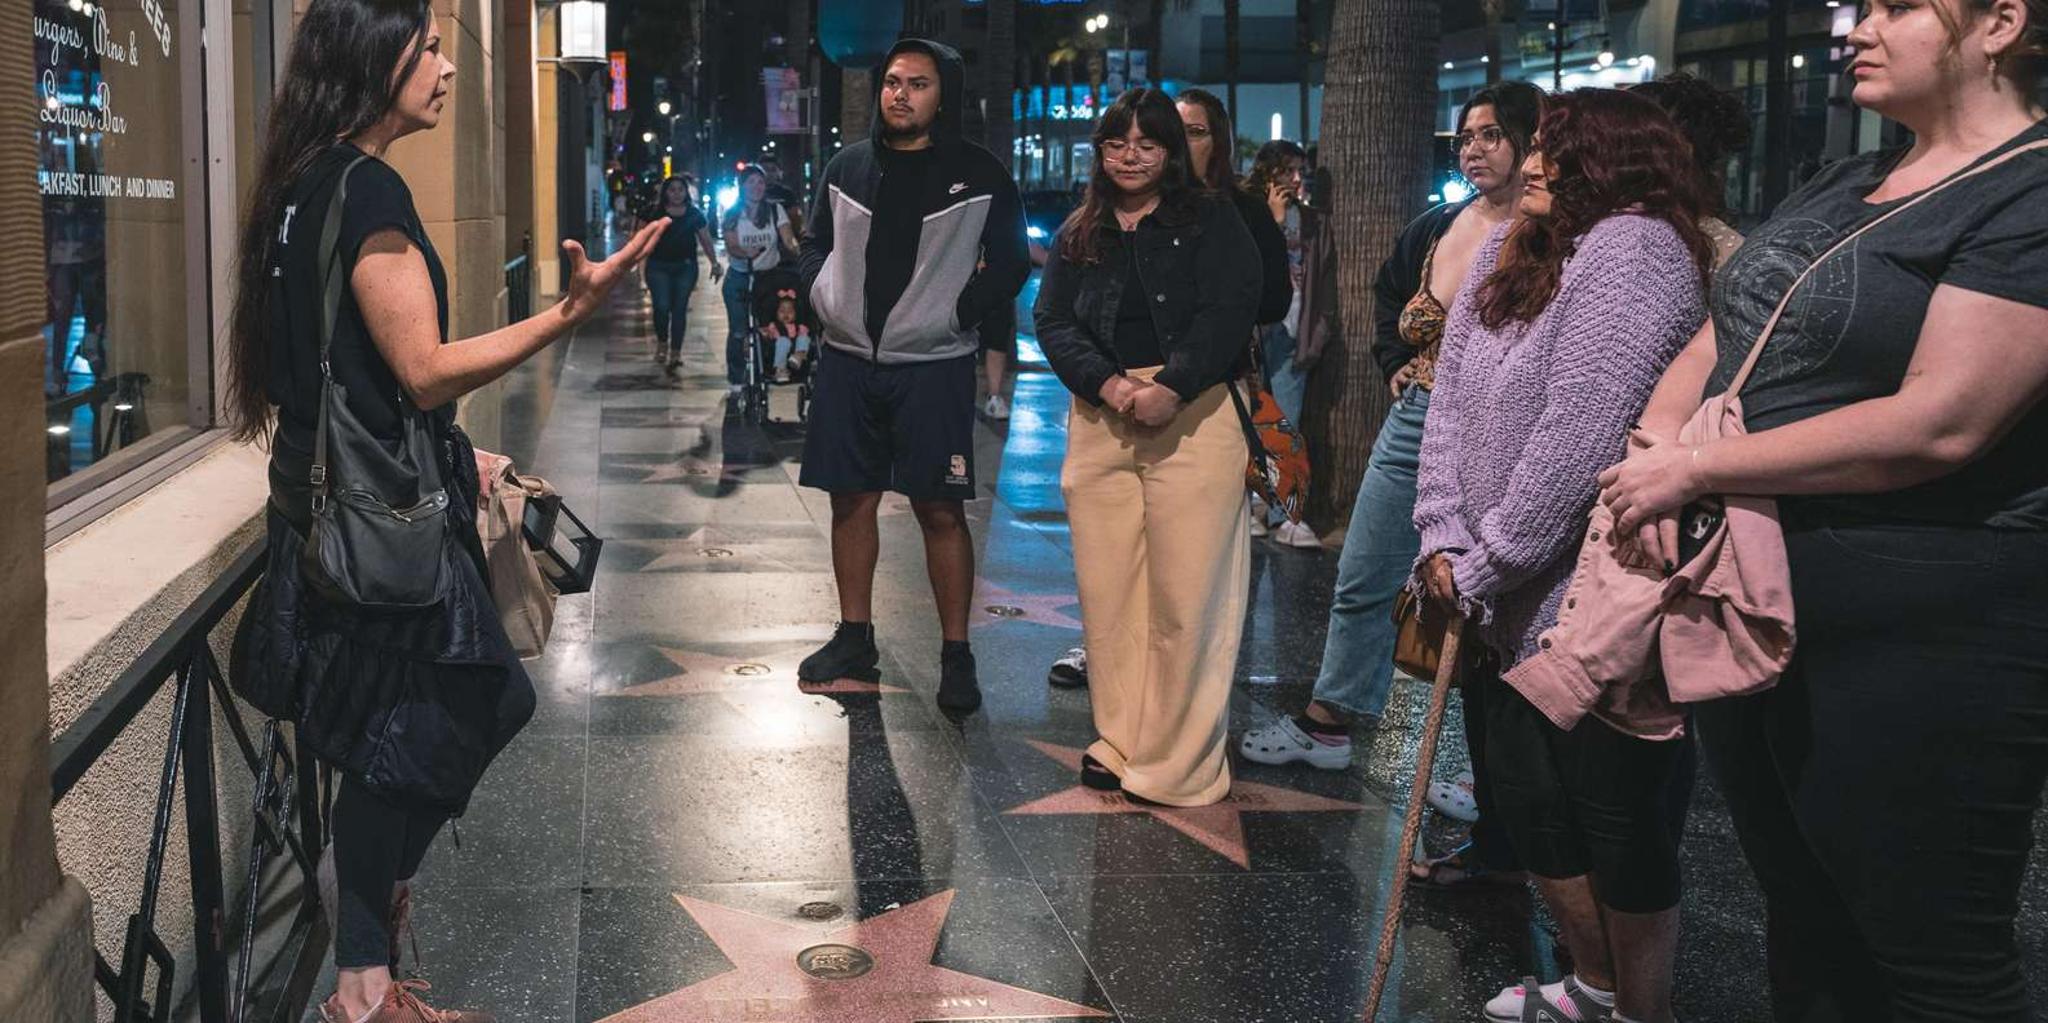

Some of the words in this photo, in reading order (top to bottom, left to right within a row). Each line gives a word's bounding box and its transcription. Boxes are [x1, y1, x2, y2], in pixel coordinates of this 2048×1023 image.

[91, 6, 126, 62] Wine
[129, 30, 139, 67] &
[40, 69, 97, 138] Liquor
[97, 82, 127, 134] Bar
[89, 174, 121, 197] LUNCH
[126, 177, 145, 197] AND
[146, 178, 175, 199] DINNER
